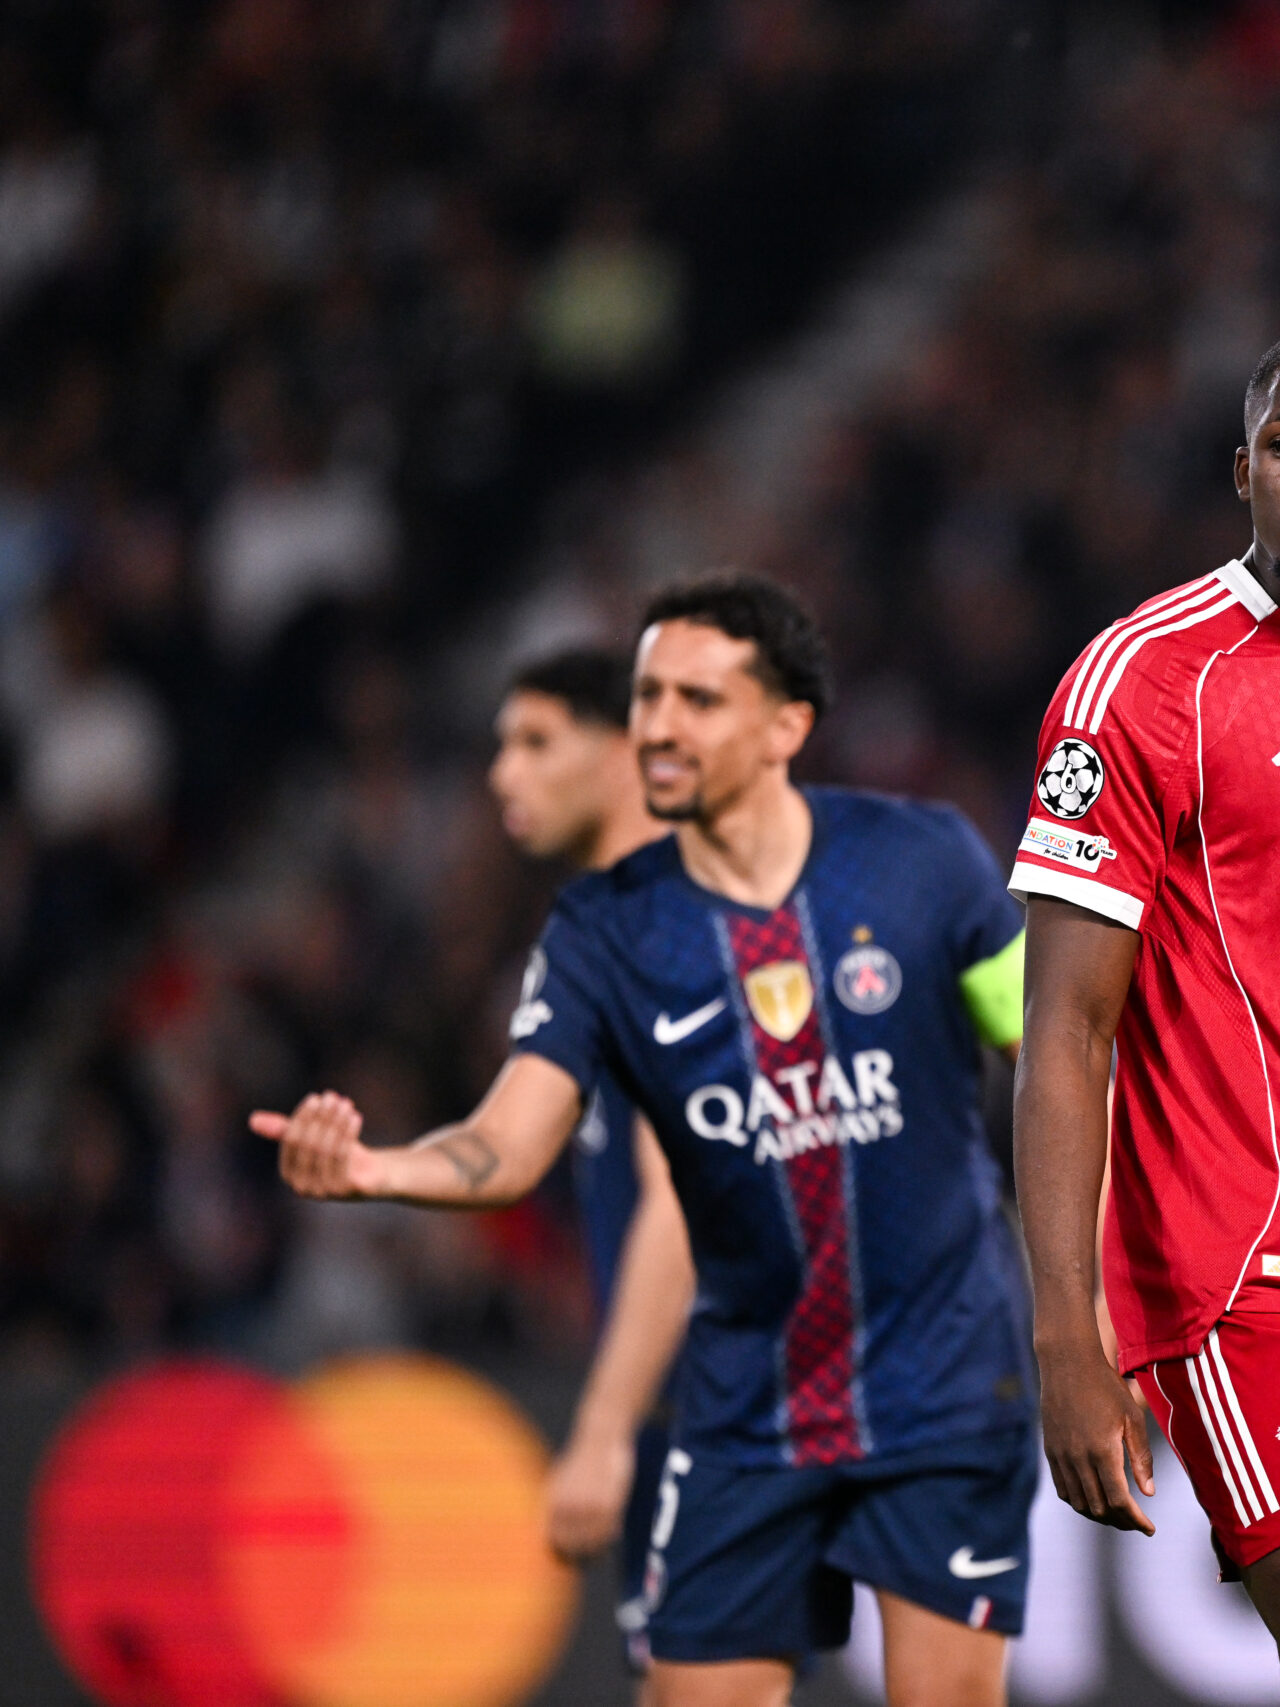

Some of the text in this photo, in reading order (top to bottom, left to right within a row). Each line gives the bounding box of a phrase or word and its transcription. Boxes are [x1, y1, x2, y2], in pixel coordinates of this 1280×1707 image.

[1076, 840, 1100, 861] 10
[686, 1048, 900, 1149] QATAR
[752, 1104, 904, 1166] AIRWAYS
